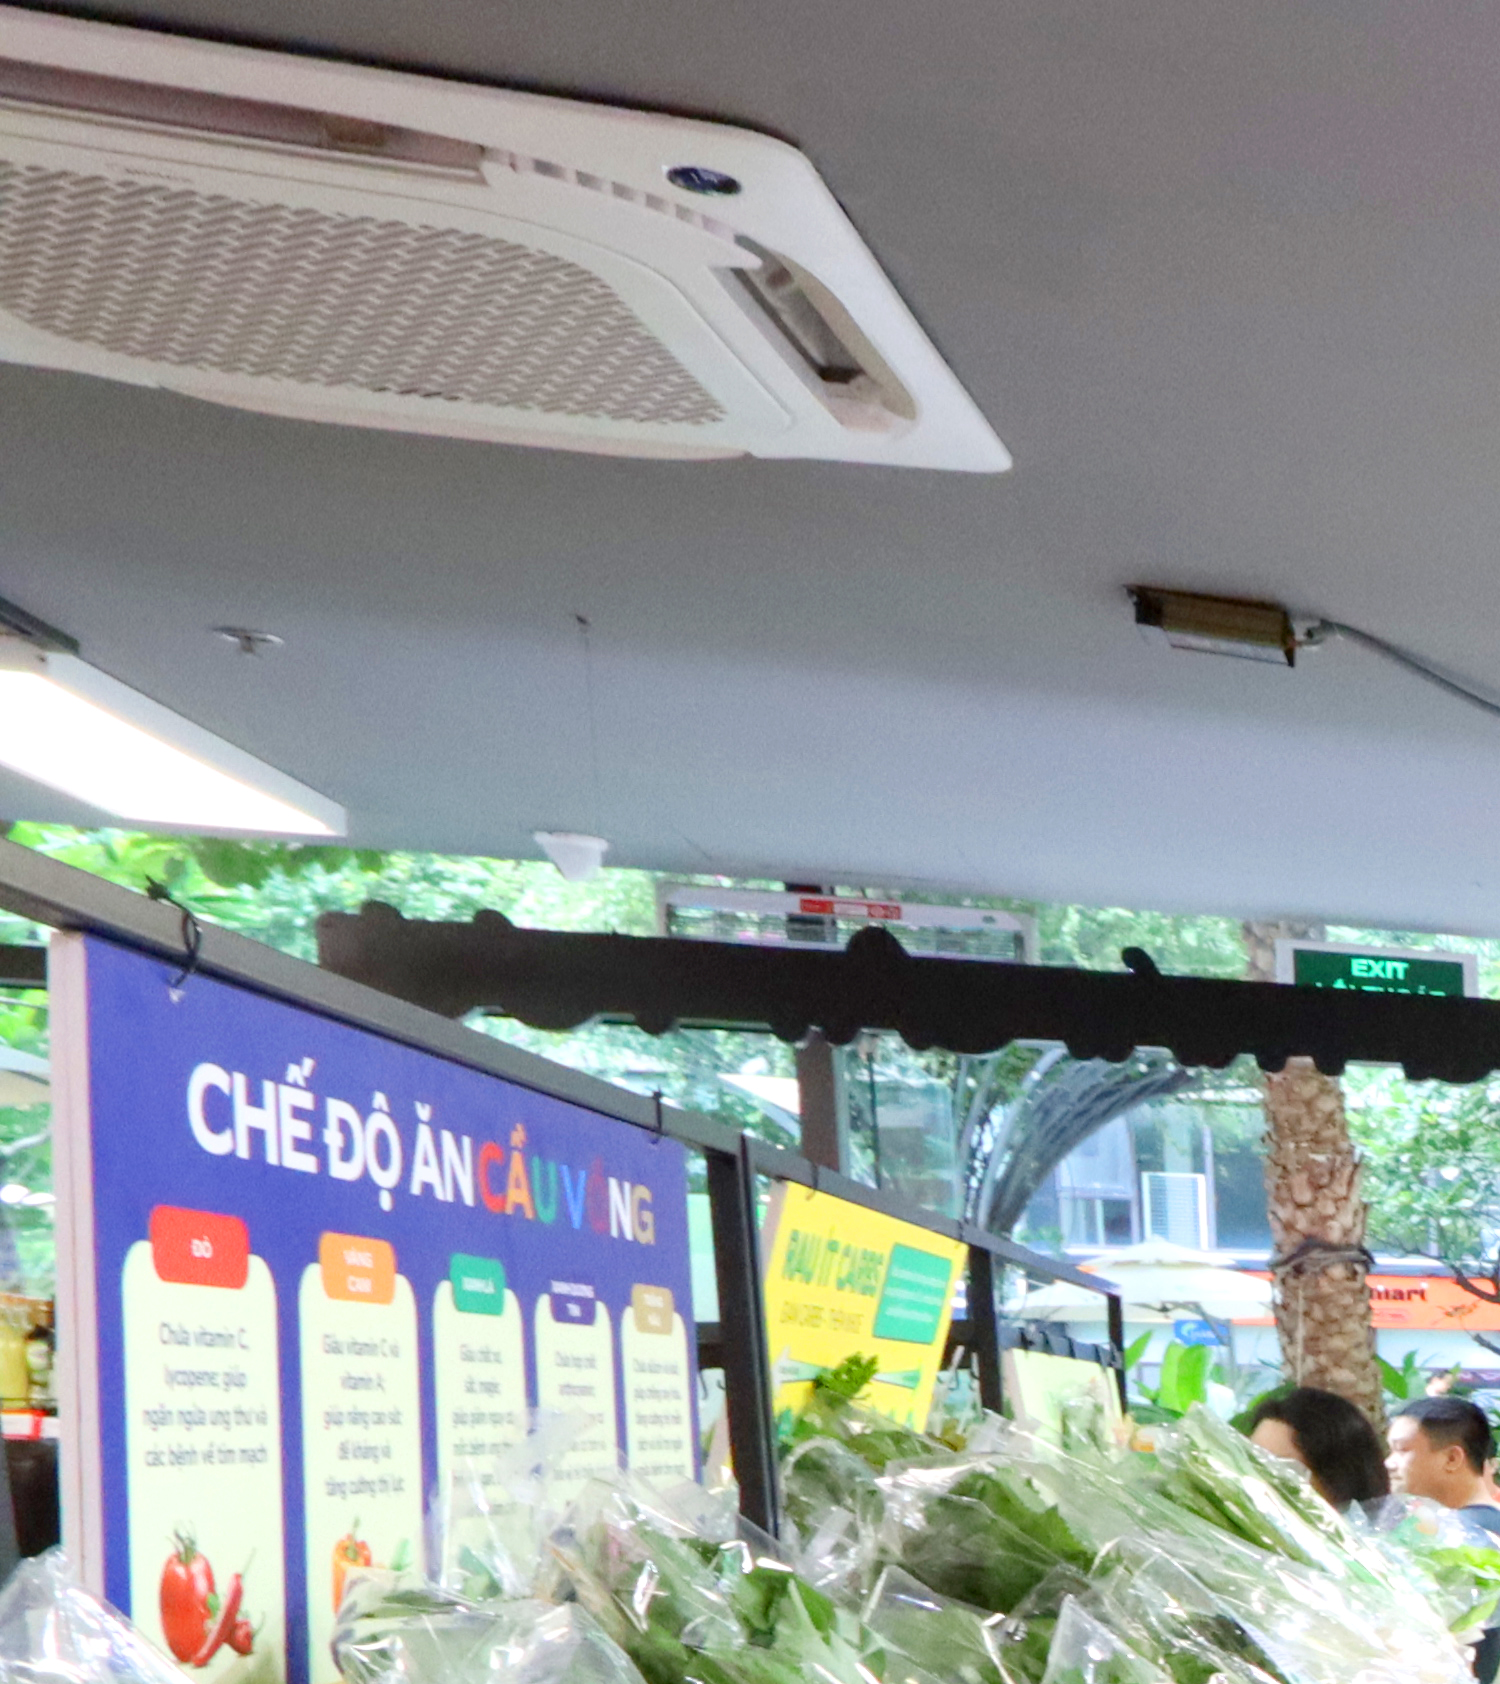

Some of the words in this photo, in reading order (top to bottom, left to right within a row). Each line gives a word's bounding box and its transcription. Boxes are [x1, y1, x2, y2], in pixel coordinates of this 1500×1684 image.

[1351, 958, 1409, 980] EXIT
[186, 1057, 318, 1174] CHẾ
[322, 1091, 402, 1212] ĐỘ
[410, 1101, 475, 1207] ĂN
